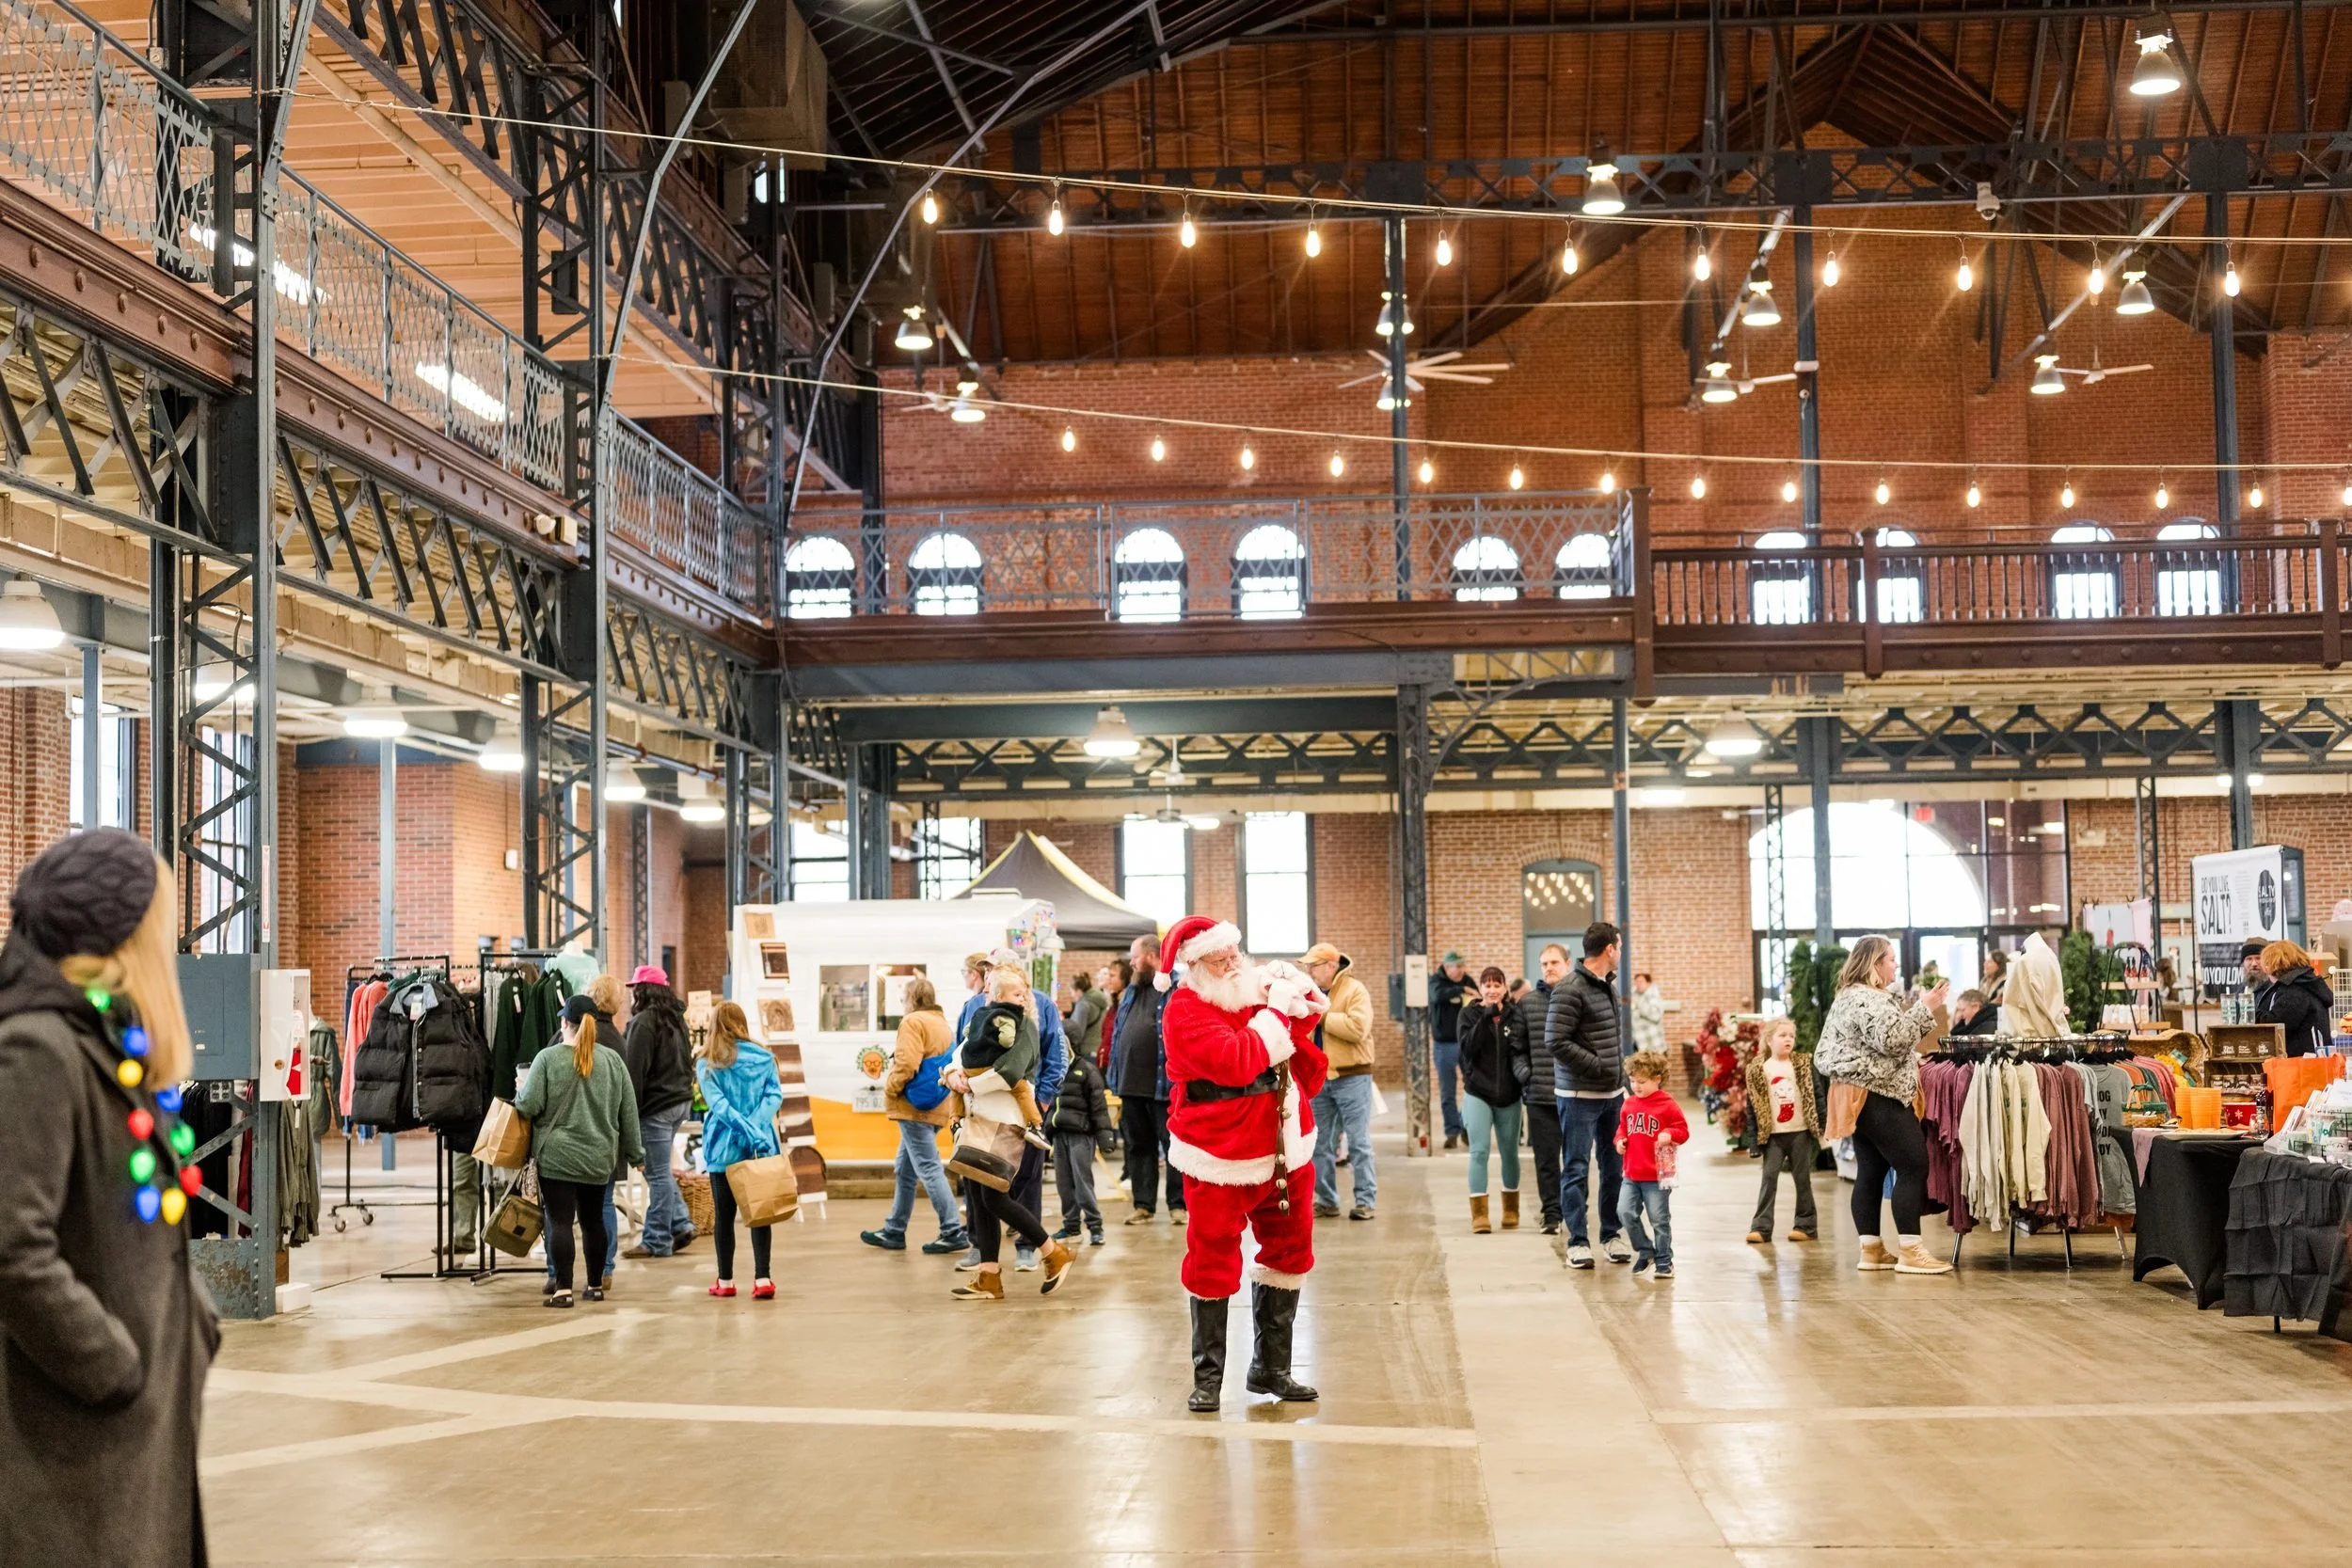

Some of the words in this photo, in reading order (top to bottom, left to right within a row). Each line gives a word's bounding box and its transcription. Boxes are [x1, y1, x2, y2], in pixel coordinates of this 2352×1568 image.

[2208, 875, 2218, 893] YOU
[2201, 894, 2232, 935] SALT?
[2210, 966, 2227, 985] YOU
[1627, 1112, 1660, 1138] GAP
